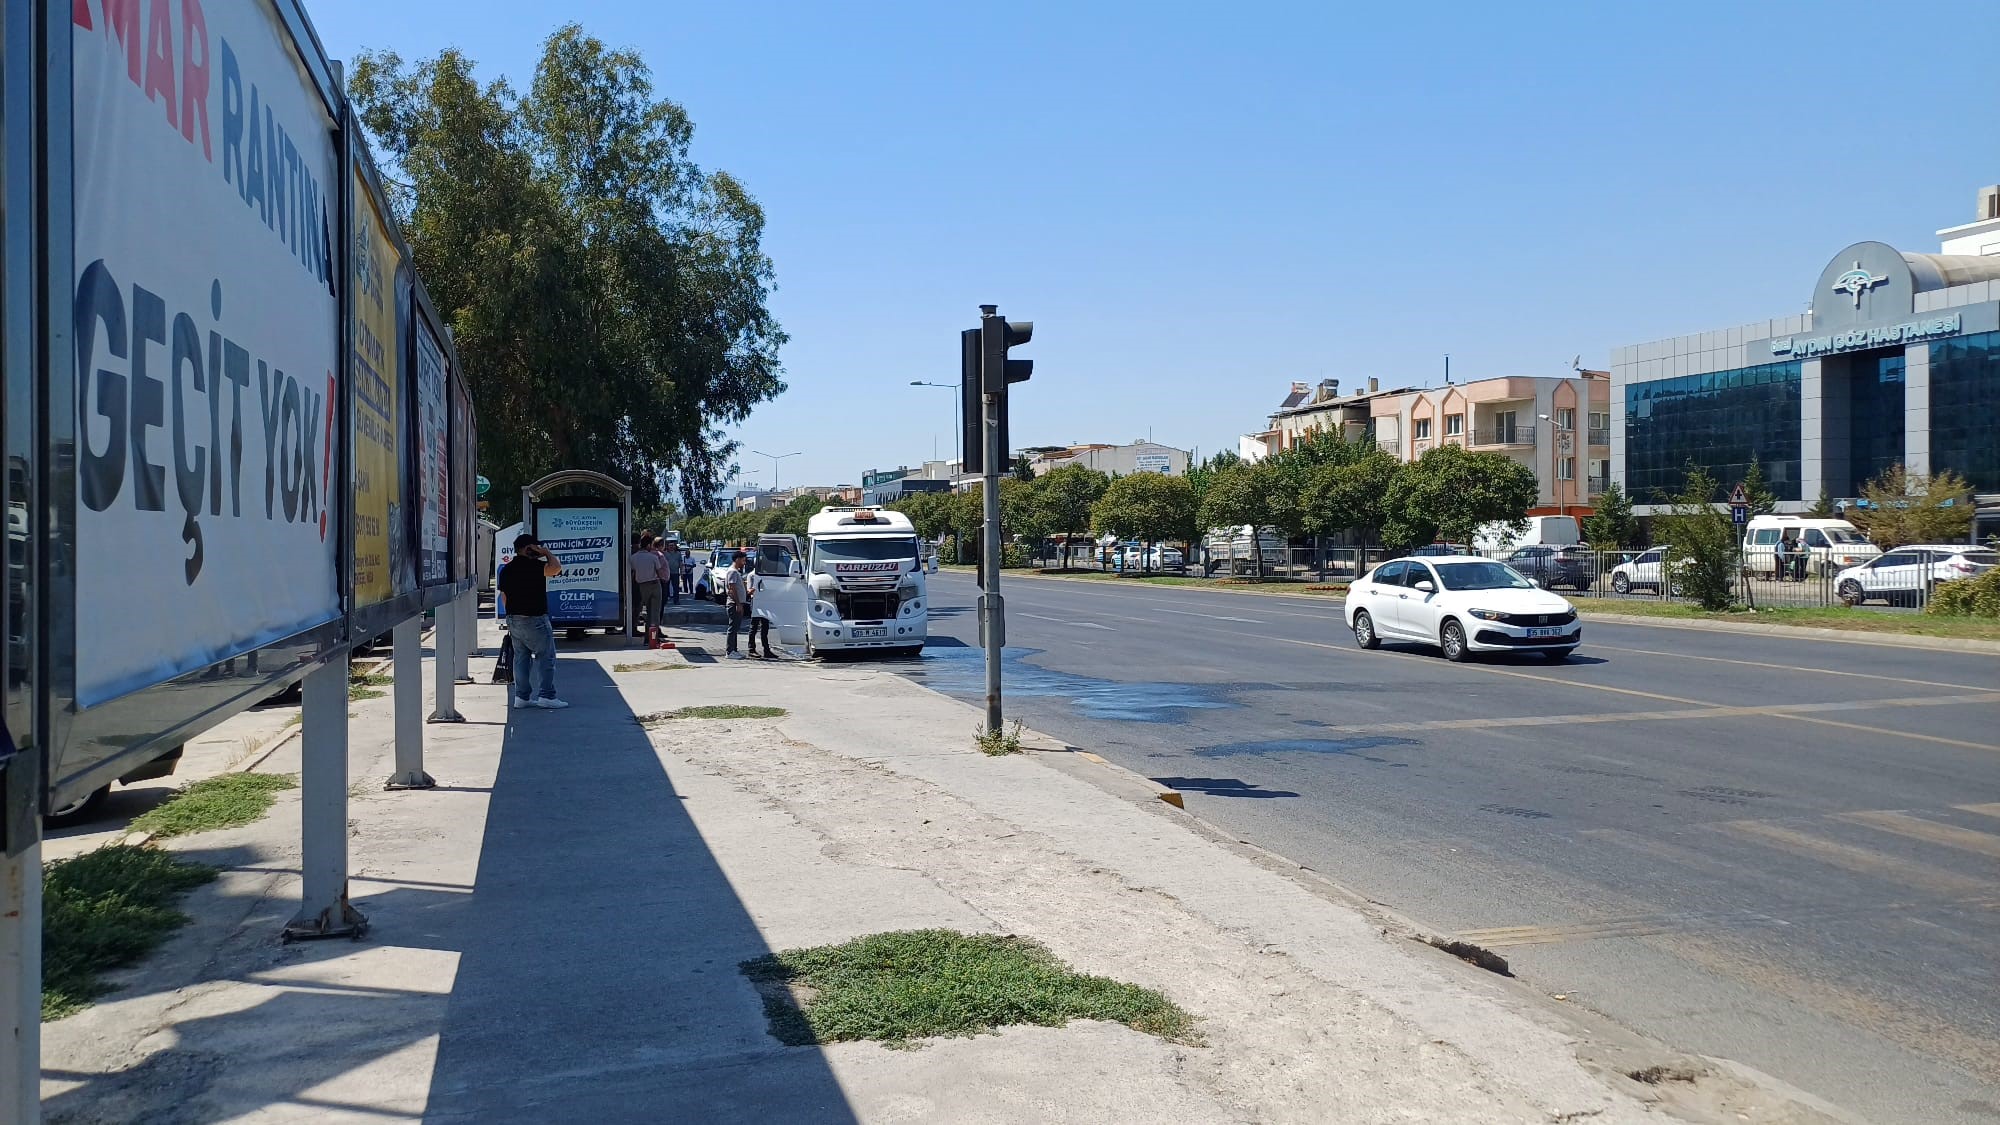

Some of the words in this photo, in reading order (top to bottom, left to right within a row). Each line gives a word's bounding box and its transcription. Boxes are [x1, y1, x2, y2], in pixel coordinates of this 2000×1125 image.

[73, 0, 212, 164] AR
[221, 36, 336, 298] RANTINA
[1790, 335, 1833, 357] AYDIN
[1833, 330, 1867, 348] GÖZ
[1868, 312, 1962, 344] HASTANESİ
[76, 258, 250, 586] GEÇİT
[258, 368, 336, 544] YOK!
[1734, 508, 1744, 522] H
[568, 540, 584, 549] İÇİN
[560, 553, 601, 562] LIŞIYORUZ
[838, 562, 897, 571] KARPUZLU
[572, 568, 586, 577] 40
[587, 567, 600, 576] 09
[560, 591, 595, 601] ÖZLEM
